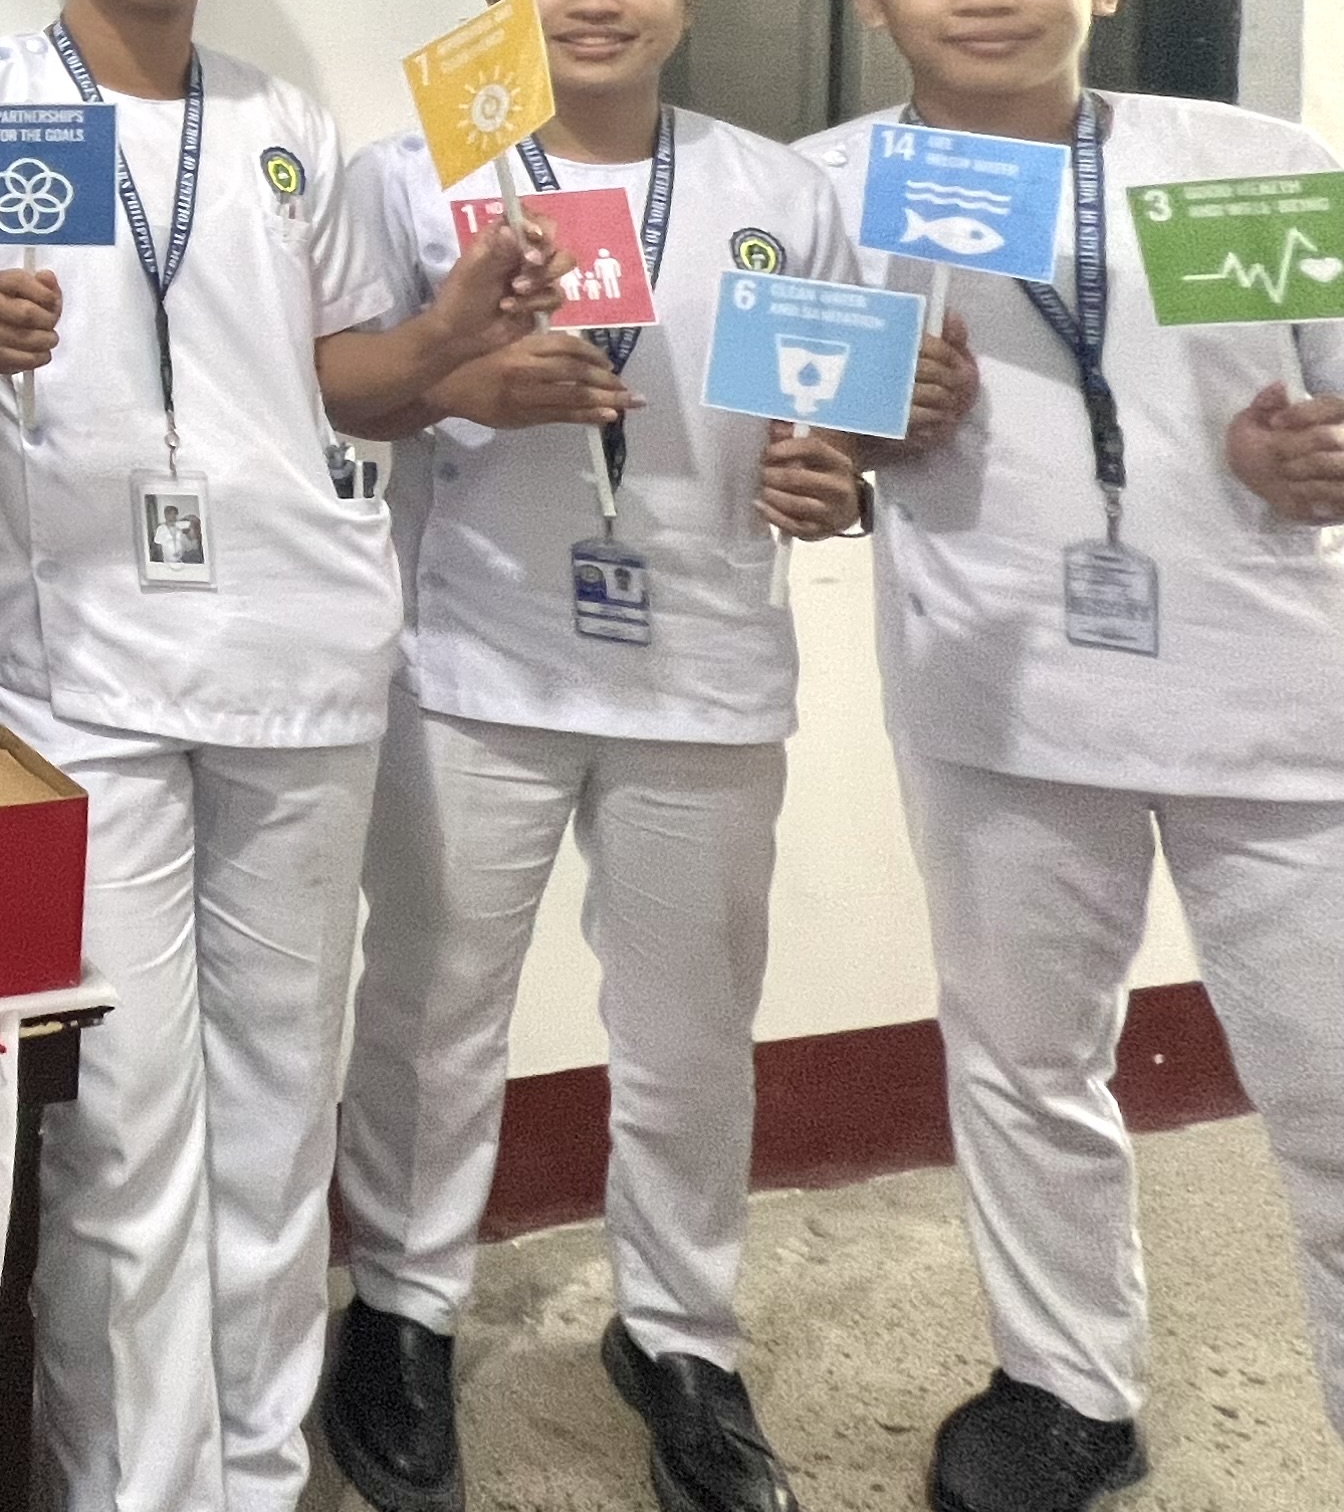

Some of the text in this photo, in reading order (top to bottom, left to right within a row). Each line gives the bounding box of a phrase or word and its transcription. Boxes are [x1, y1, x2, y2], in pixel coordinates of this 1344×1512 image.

[21, 129, 41, 142] THE
[45, 129, 84, 142] GOALS
[881, 130, 915, 161] 14
[182, 153, 197, 171] OF
[519, 137, 553, 185] OLLEGES
[175, 171, 195, 232] COLLEGES
[648, 163, 671, 224] NORTHERN
[1144, 190, 1172, 221] 3
[123, 192, 158, 273] PHILIPPINES
[461, 204, 478, 233] 1
[734, 279, 756, 310] 6
